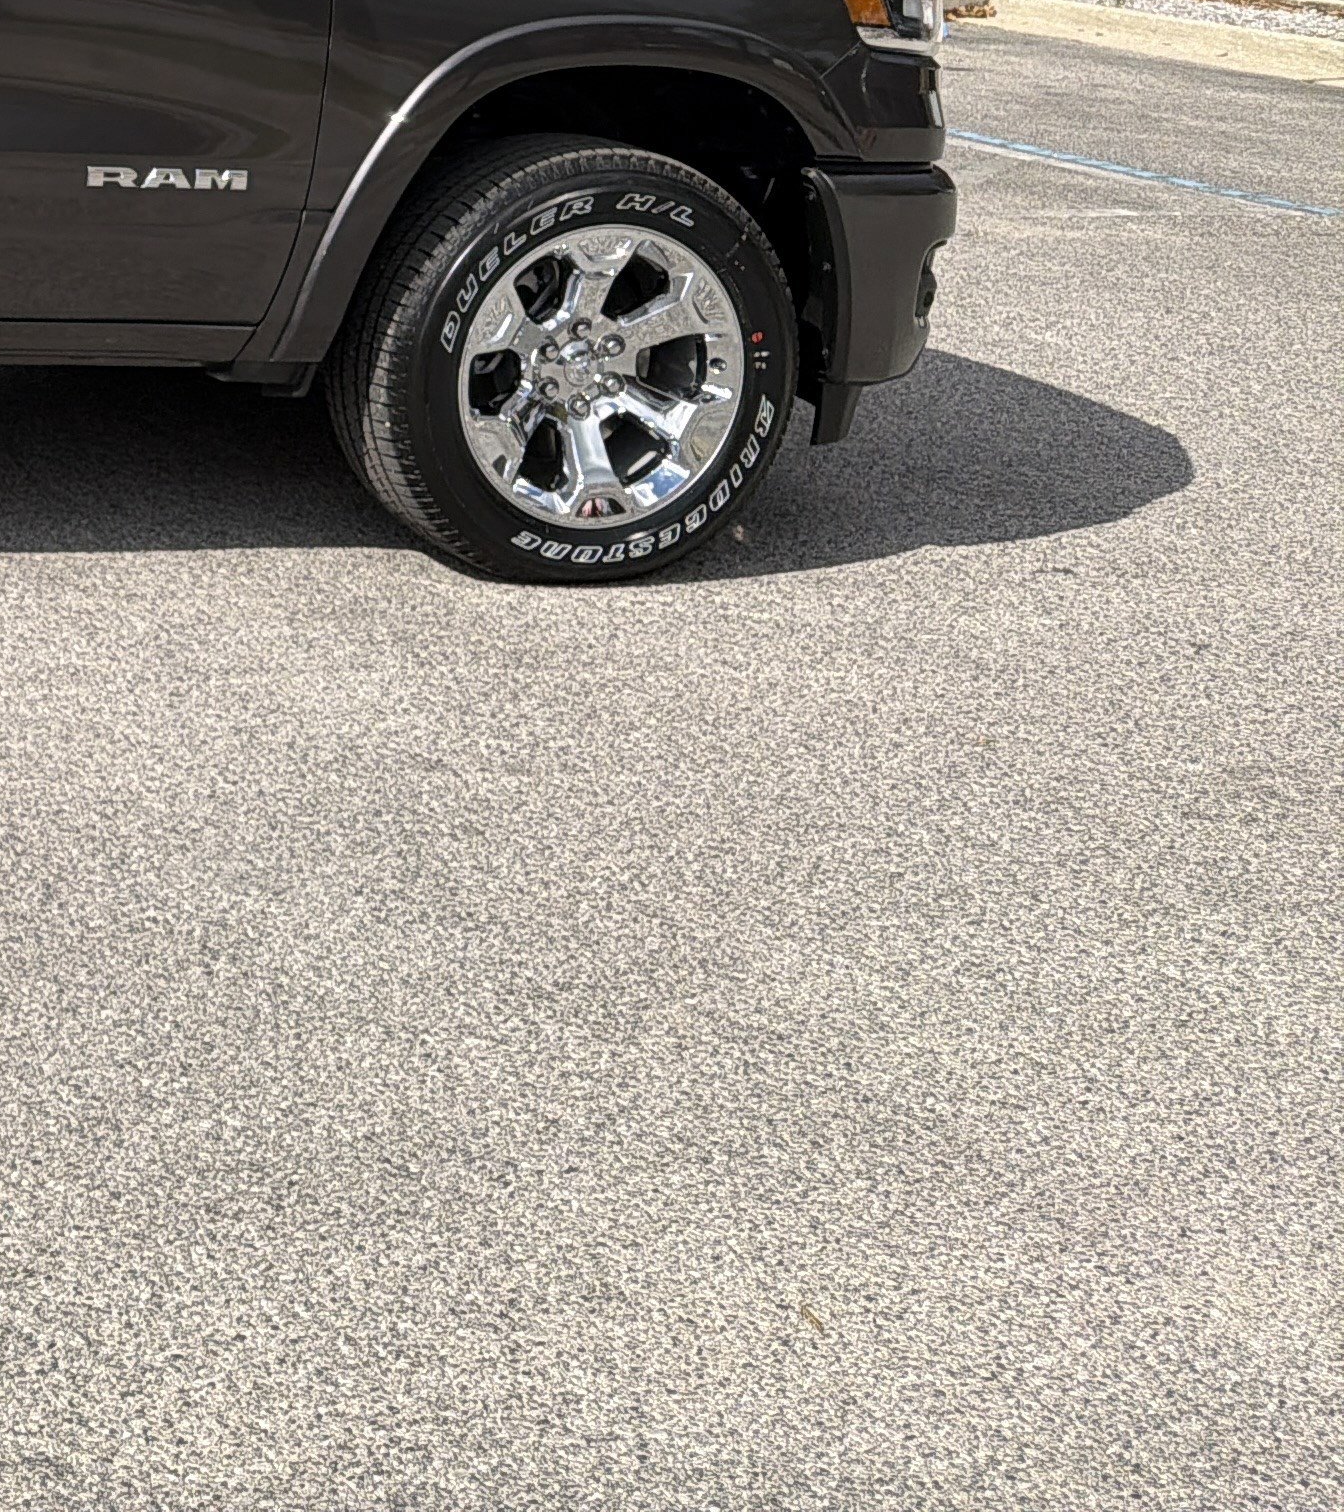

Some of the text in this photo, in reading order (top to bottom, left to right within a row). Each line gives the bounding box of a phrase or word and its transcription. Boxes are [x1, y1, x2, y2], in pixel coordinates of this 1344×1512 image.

[86, 165, 249, 190] RAM
[439, 192, 696, 354] DUELER H/L
[510, 393, 776, 565] BRIDGESTONE
